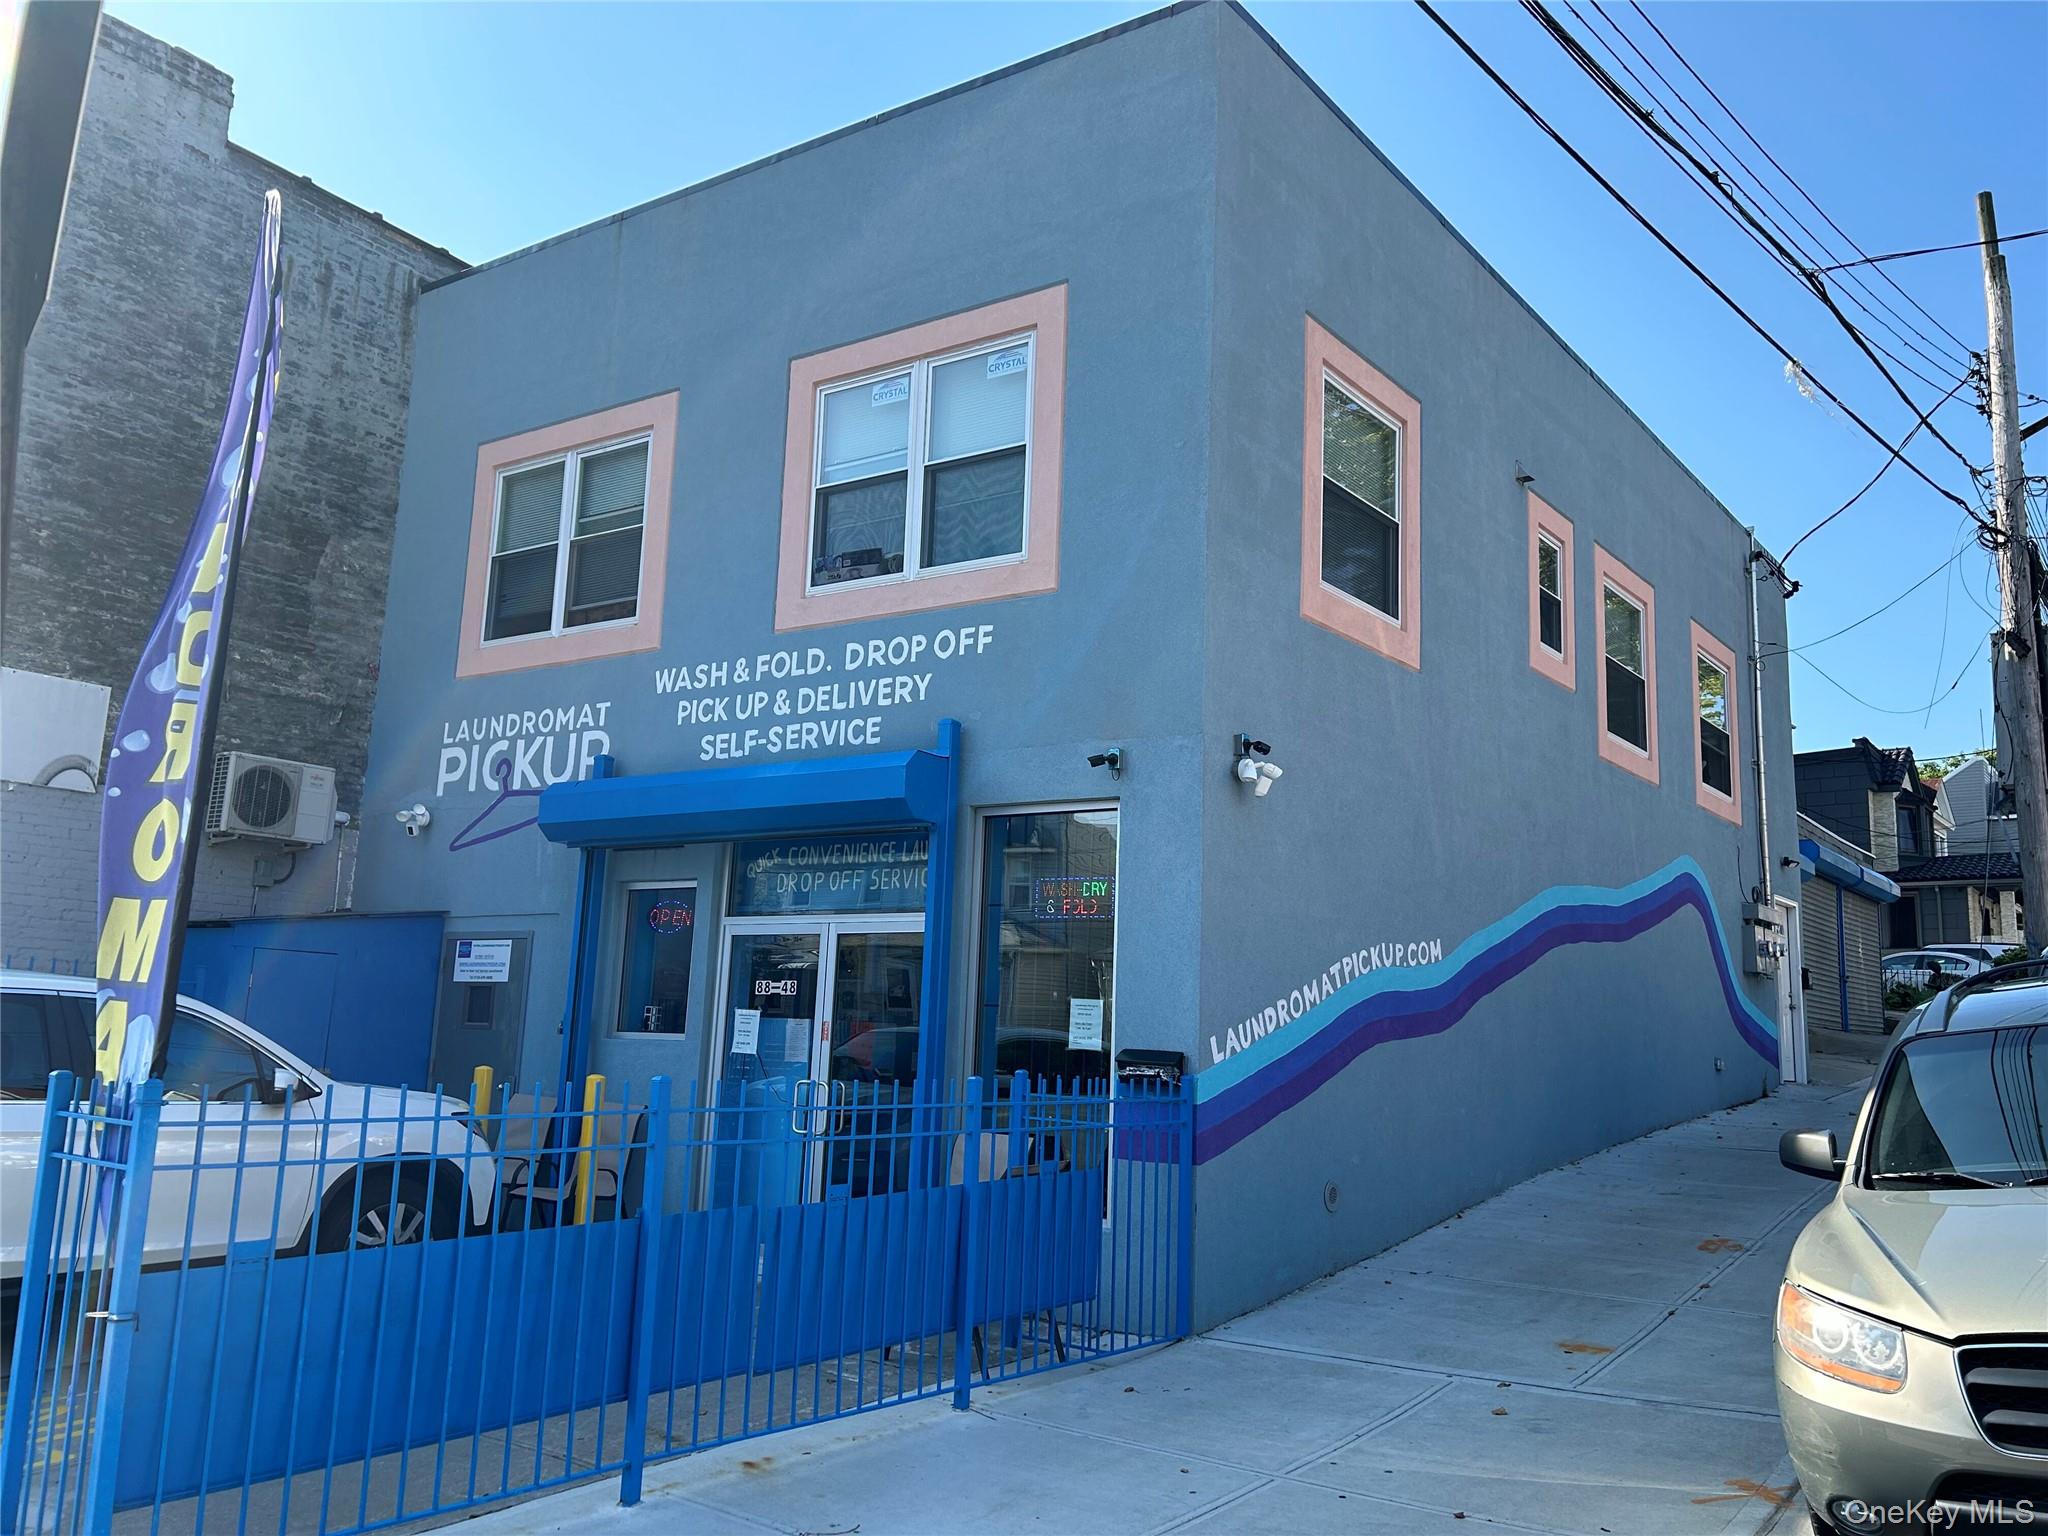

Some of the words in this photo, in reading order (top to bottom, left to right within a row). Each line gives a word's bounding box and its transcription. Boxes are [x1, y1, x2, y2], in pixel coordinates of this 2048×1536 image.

[988, 355, 1027, 373] CRYSTAL
[872, 386, 908, 402] CRYSTAL
[655, 661, 728, 695] WASH
[733, 657, 751, 683] &
[756, 647, 833, 686] FOLD.
[844, 635, 928, 672] DROP
[932, 625, 995, 660] OFF
[676, 694, 729, 725] PICK
[735, 688, 770, 718] UP
[773, 690, 793, 715] &
[796, 673, 932, 715] DELIVERY
[443, 701, 612, 744] LAUNDROMAT
[699, 716, 883, 761] SELF-SERVICE
[436, 729, 611, 797] PICKUP
[746, 847, 783, 879] QUICK
[788, 841, 897, 866] CONVENIENCE
[902, 839, 928, 861] LAU
[776, 872, 826, 893] DROP
[829, 870, 865, 891] OFF
[869, 868, 928, 890] SERVIC
[650, 909, 692, 926] OPEN
[756, 981, 797, 994] 88-48
[1209, 938, 1442, 1064] LAUNDROMATPICKUP.COM
